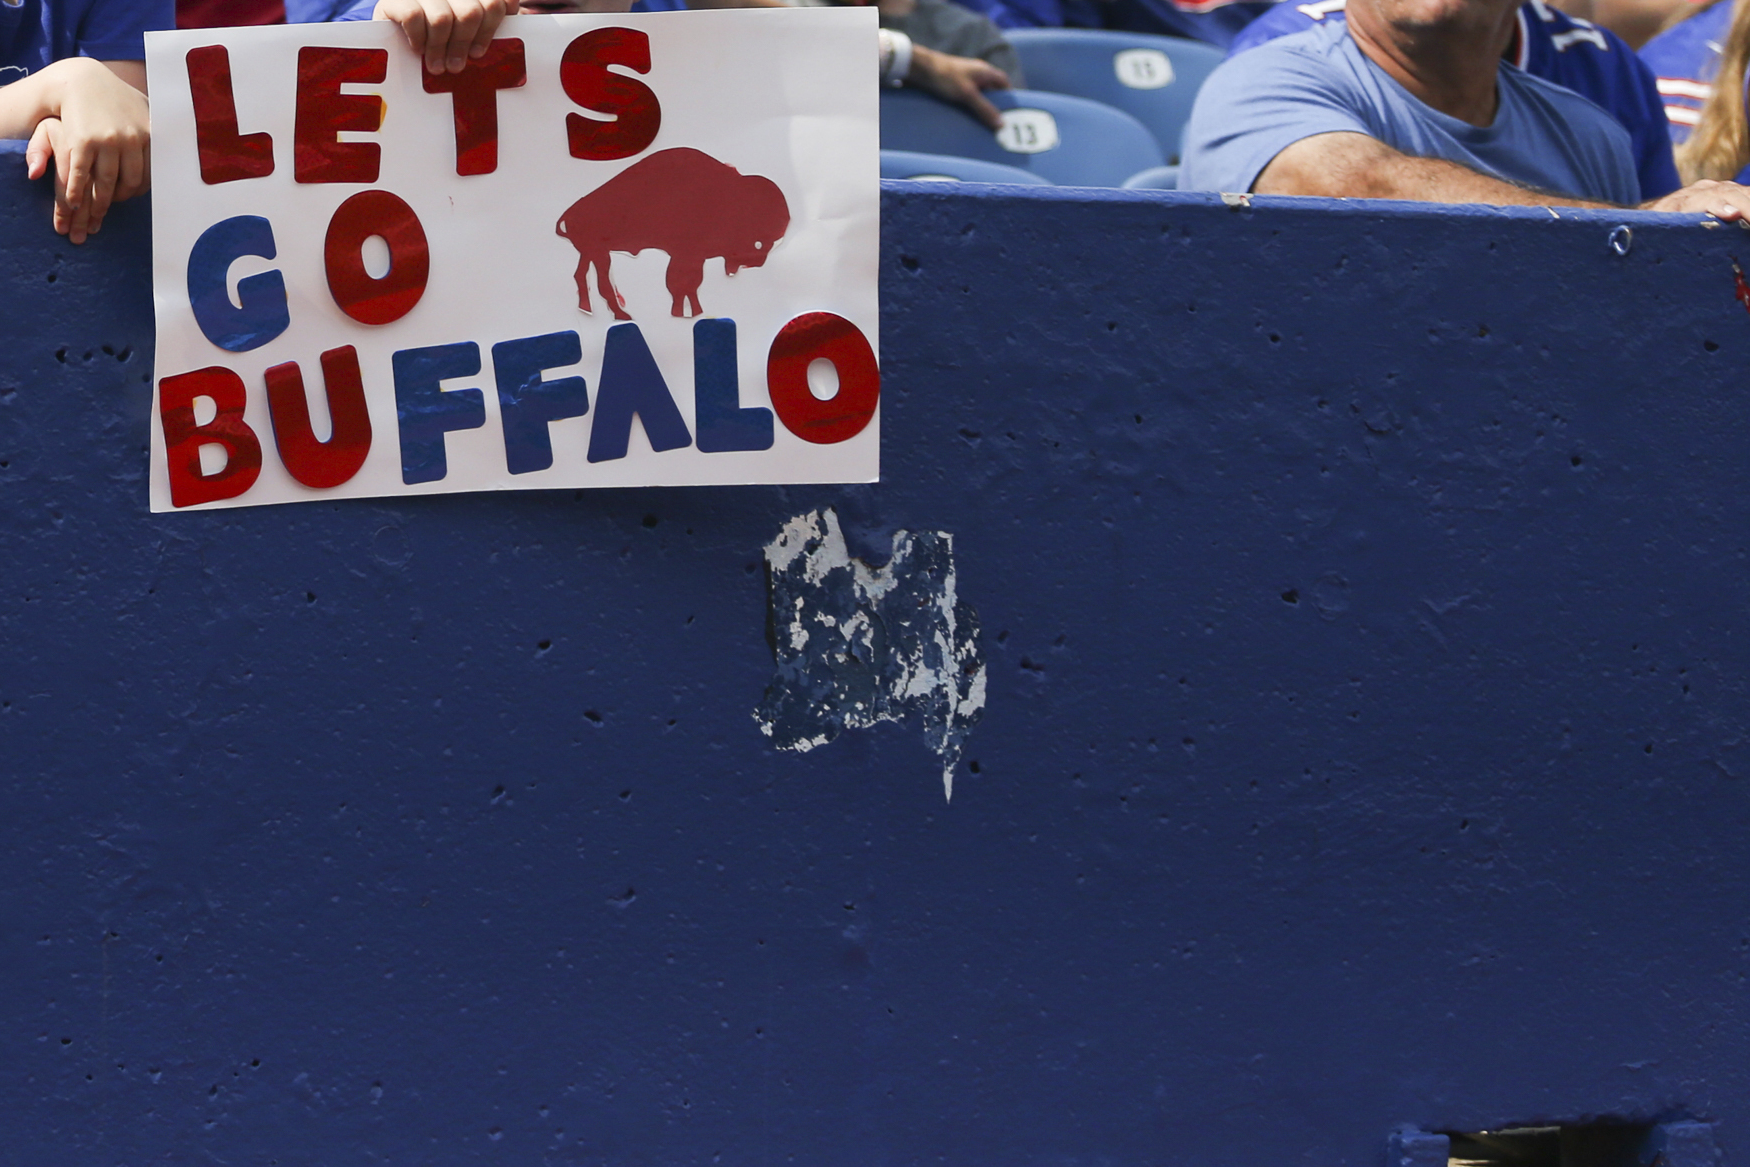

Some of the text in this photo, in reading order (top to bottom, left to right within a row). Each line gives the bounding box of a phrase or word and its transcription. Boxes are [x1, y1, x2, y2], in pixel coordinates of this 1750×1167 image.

[186, 27, 661, 184] LETS
[1011, 123, 1038, 145] 13
[187, 190, 430, 352] GO
[159, 311, 881, 509] BUFFALO
